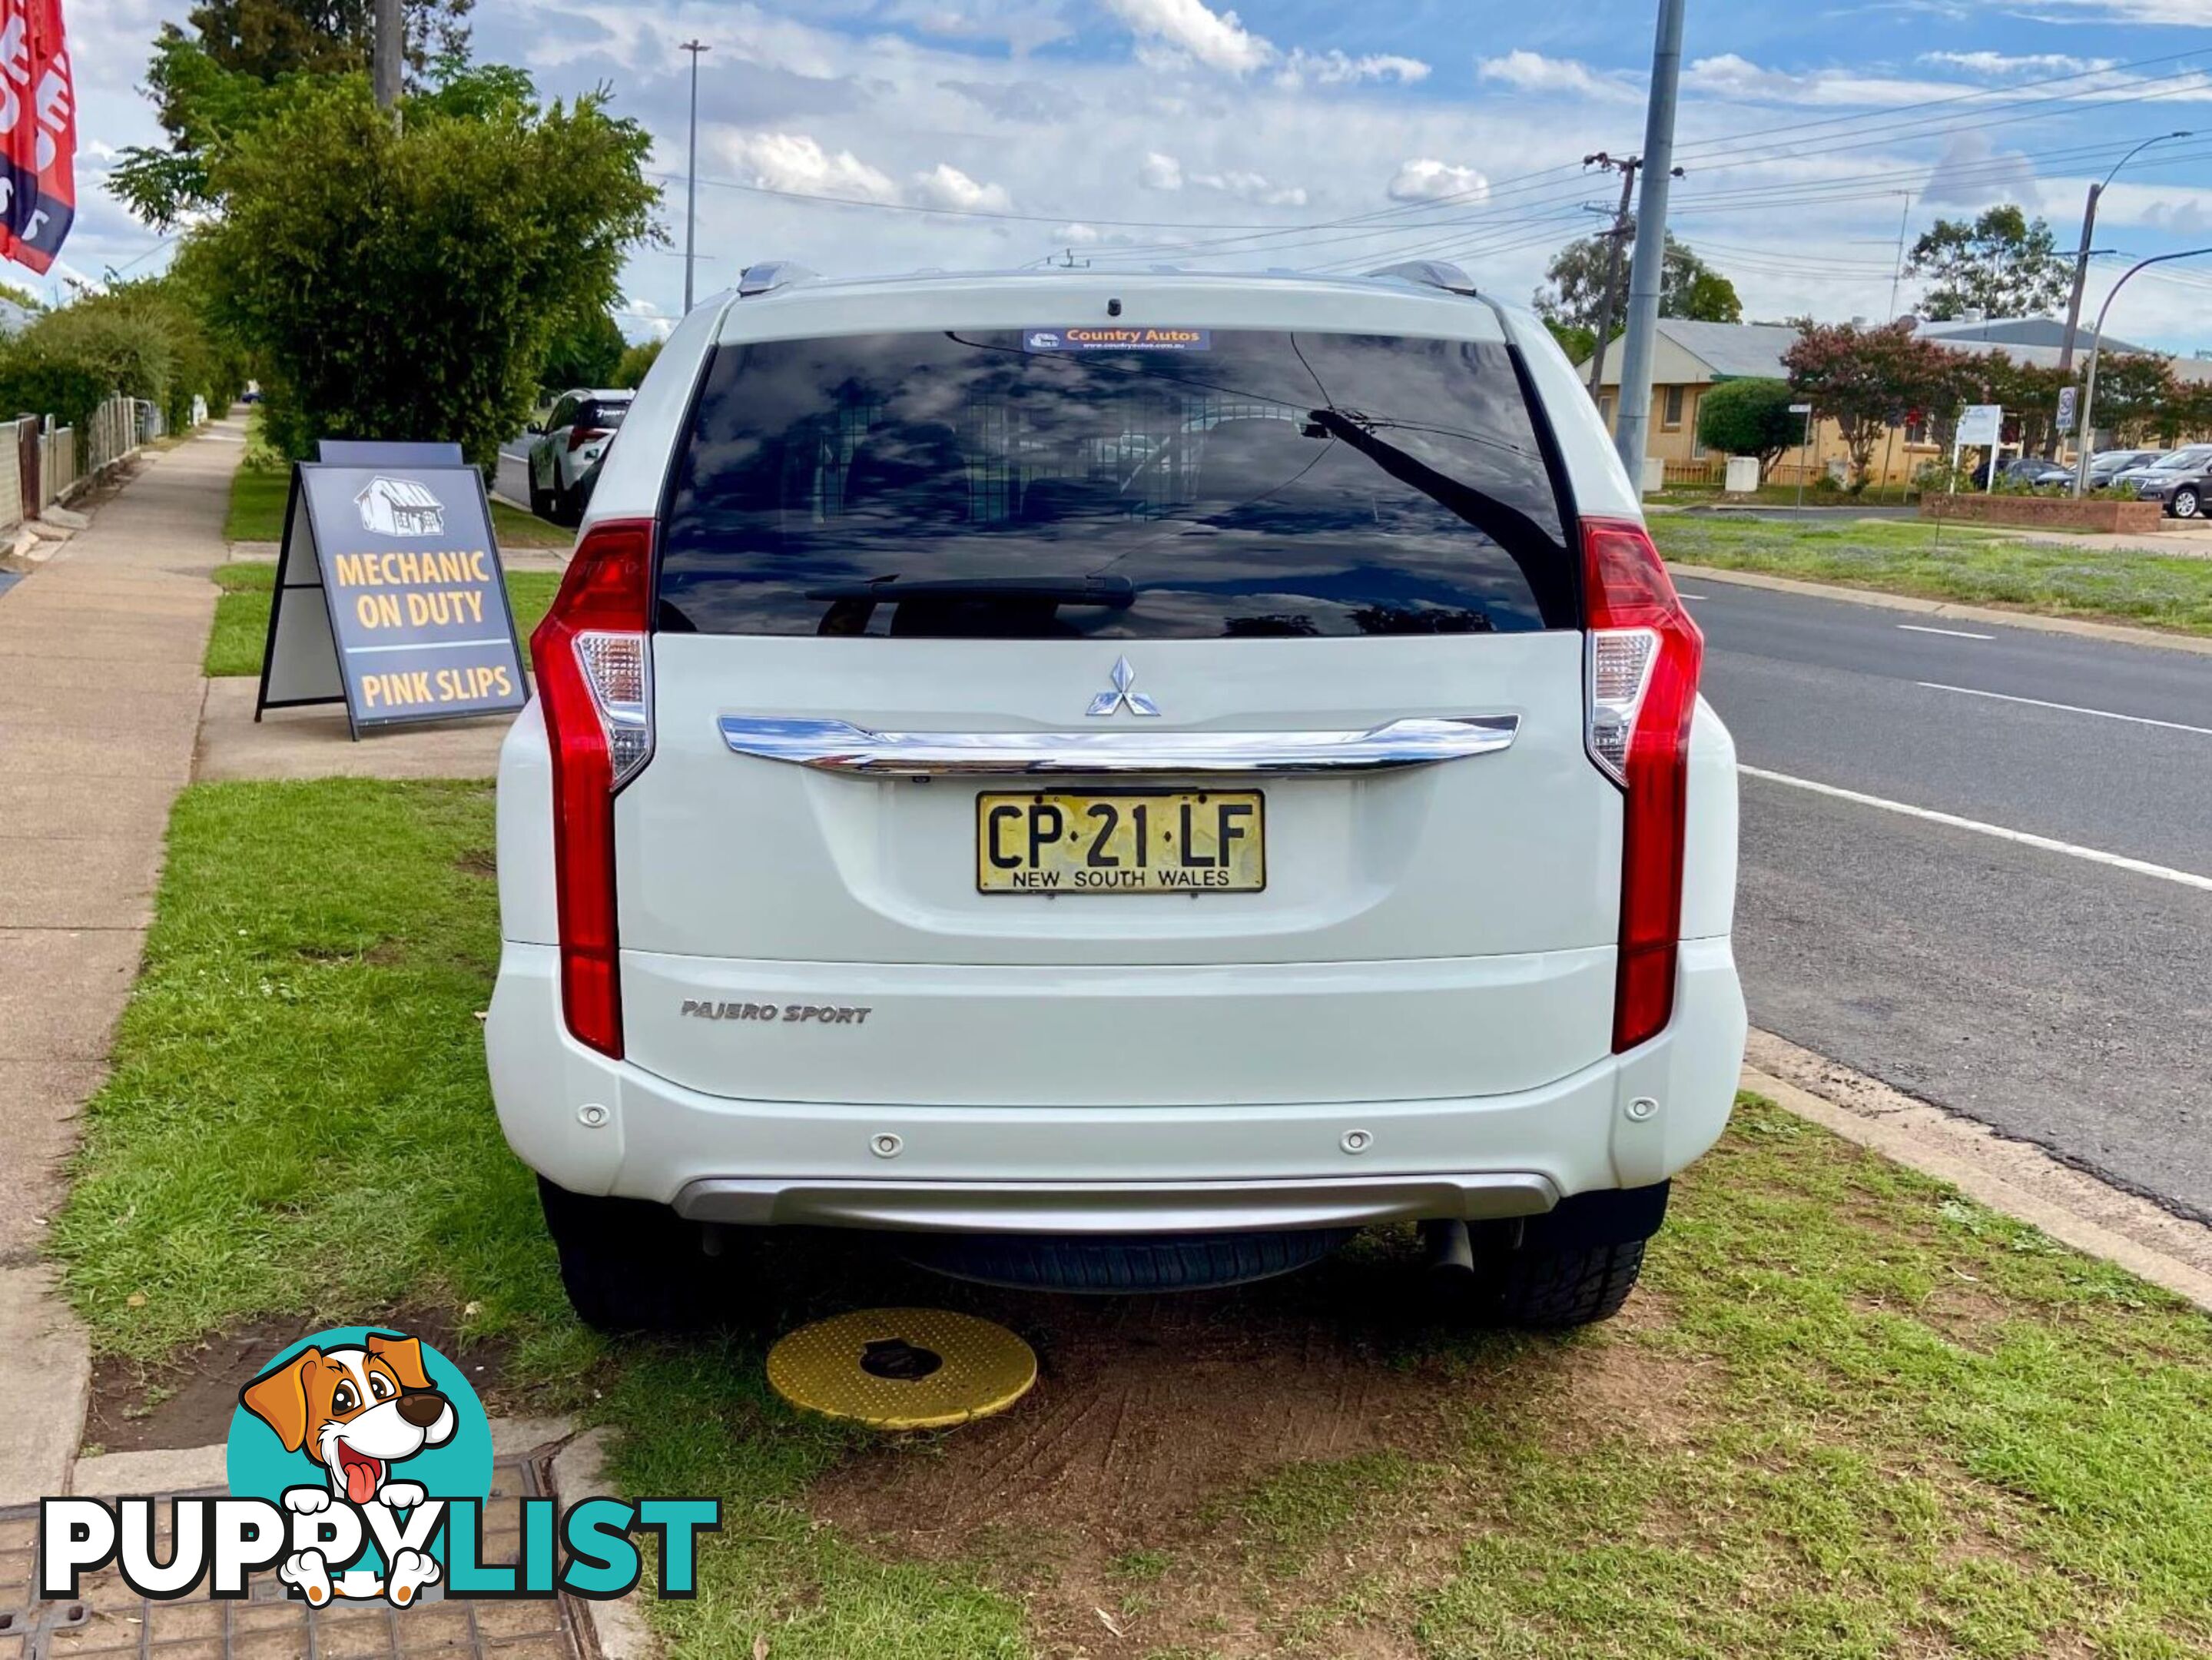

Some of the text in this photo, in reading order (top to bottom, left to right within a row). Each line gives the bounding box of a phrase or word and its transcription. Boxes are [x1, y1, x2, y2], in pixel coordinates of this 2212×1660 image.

[1066, 329, 1200, 344] Country Autos
[334, 550, 490, 587] MECHANIC
[356, 590, 483, 630] ON DUTY
[360, 666, 512, 708] PINK SLIPS
[1013, 870, 1229, 888] NEW SOUTH WALES
[681, 998, 872, 1024] PAJERO SPORT
